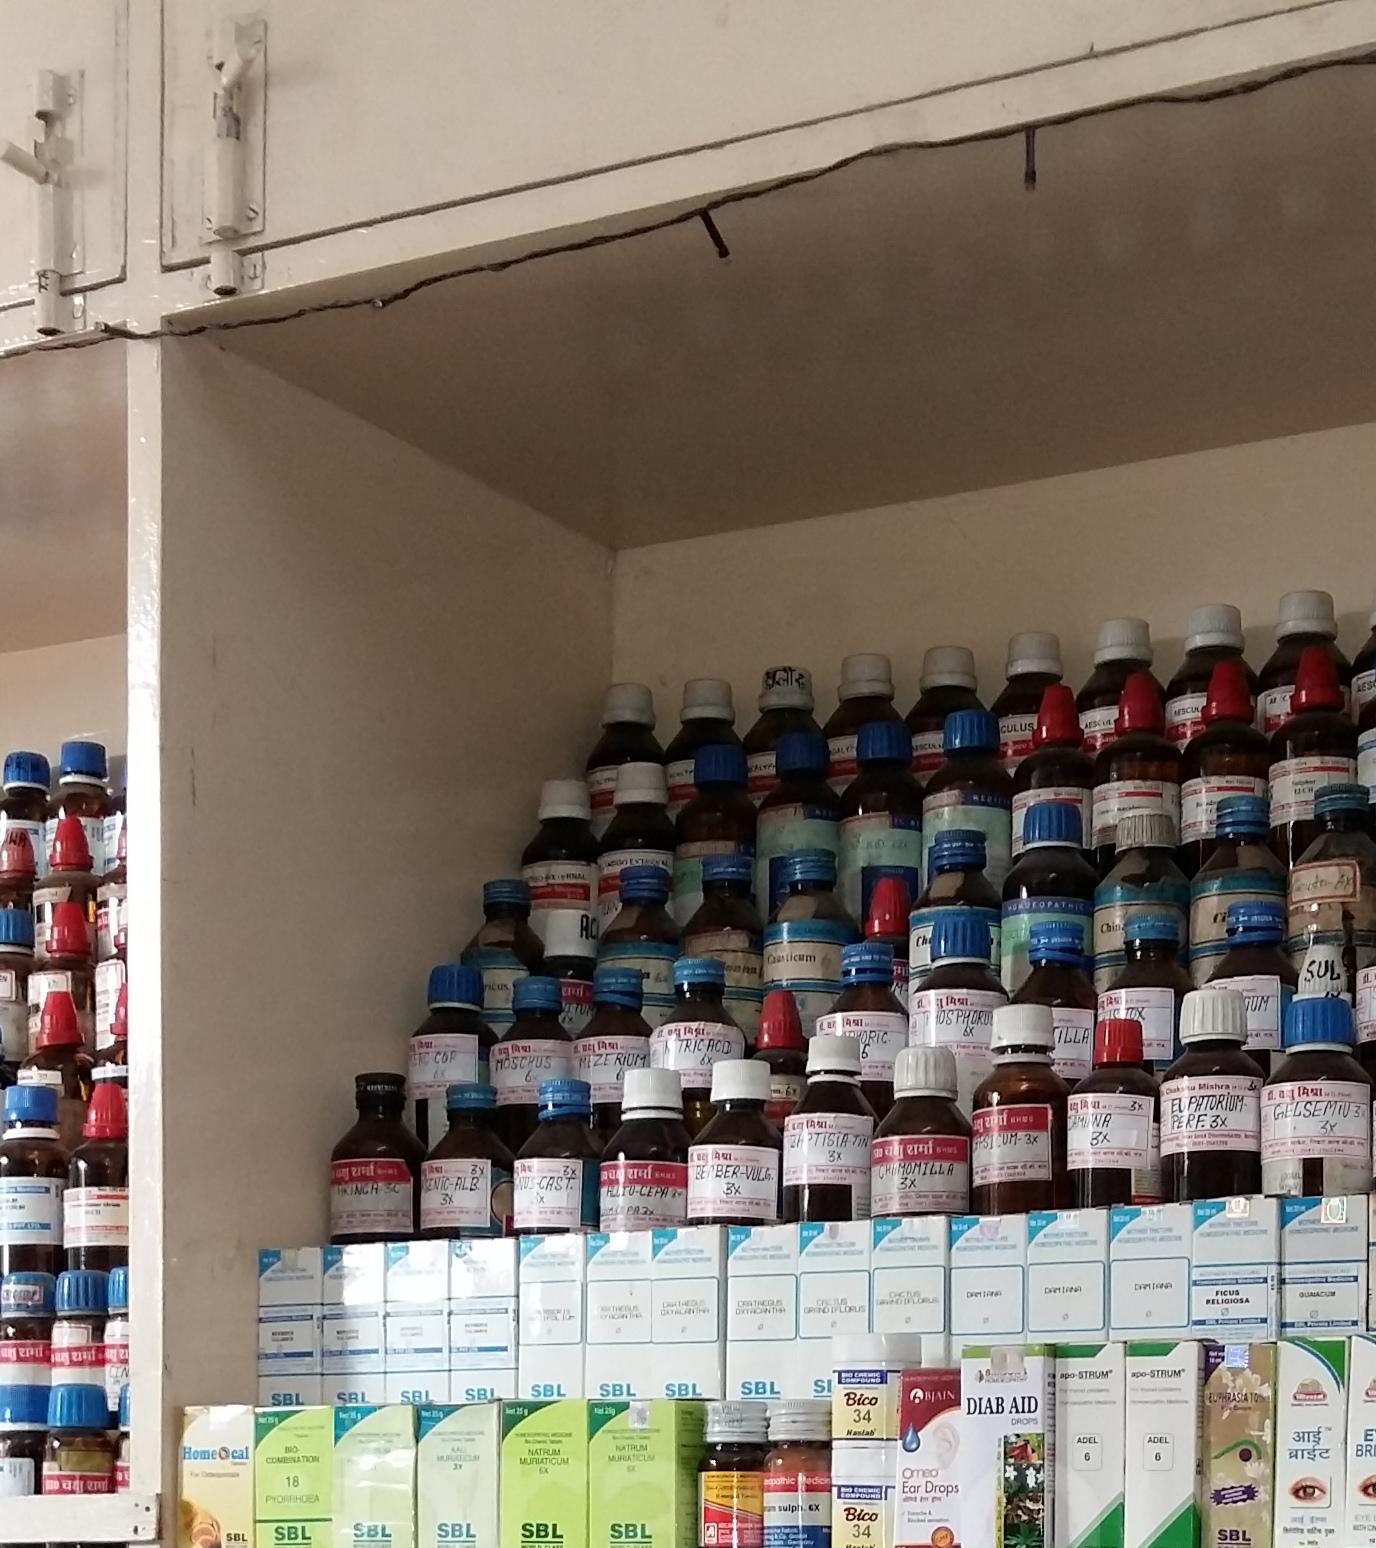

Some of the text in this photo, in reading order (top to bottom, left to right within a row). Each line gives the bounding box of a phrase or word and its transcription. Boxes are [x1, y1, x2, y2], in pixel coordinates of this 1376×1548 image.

[1215, 1289, 1240, 1297] FICUS
[1206, 1296, 1251, 1306] RELIGIOSA
[400, 1389, 430, 1403] SBL
[465, 1387, 497, 1400] SBL
[531, 1383, 569, 1398] SBL
[925, 1391, 955, 1401] BJAIN
[272, 1392, 305, 1405] SBL
[337, 1392, 368, 1403] SBL
[844, 1392, 879, 1407] Bico
[967, 1395, 1038, 1416] DIAB AID
[853, 1409, 872, 1424] 34
[846, 1428, 875, 1437] Haslab
[1292, 1426, 1322, 1443] आई
[1076, 1436, 1099, 1445] ADEL
[1147, 1436, 1170, 1445] ADEL
[266, 1456, 319, 1464] COMBINATION
[1084, 1452, 1091, 1462] 6
[1154, 1452, 1161, 1462] 6
[285, 1476, 300, 1488] 18
[902, 1480, 959, 1497] Ear Drops
[265, 1494, 319, 1504] PYORRHOEA
[844, 1507, 879, 1522] Bico
[852, 1524, 871, 1538] 34
